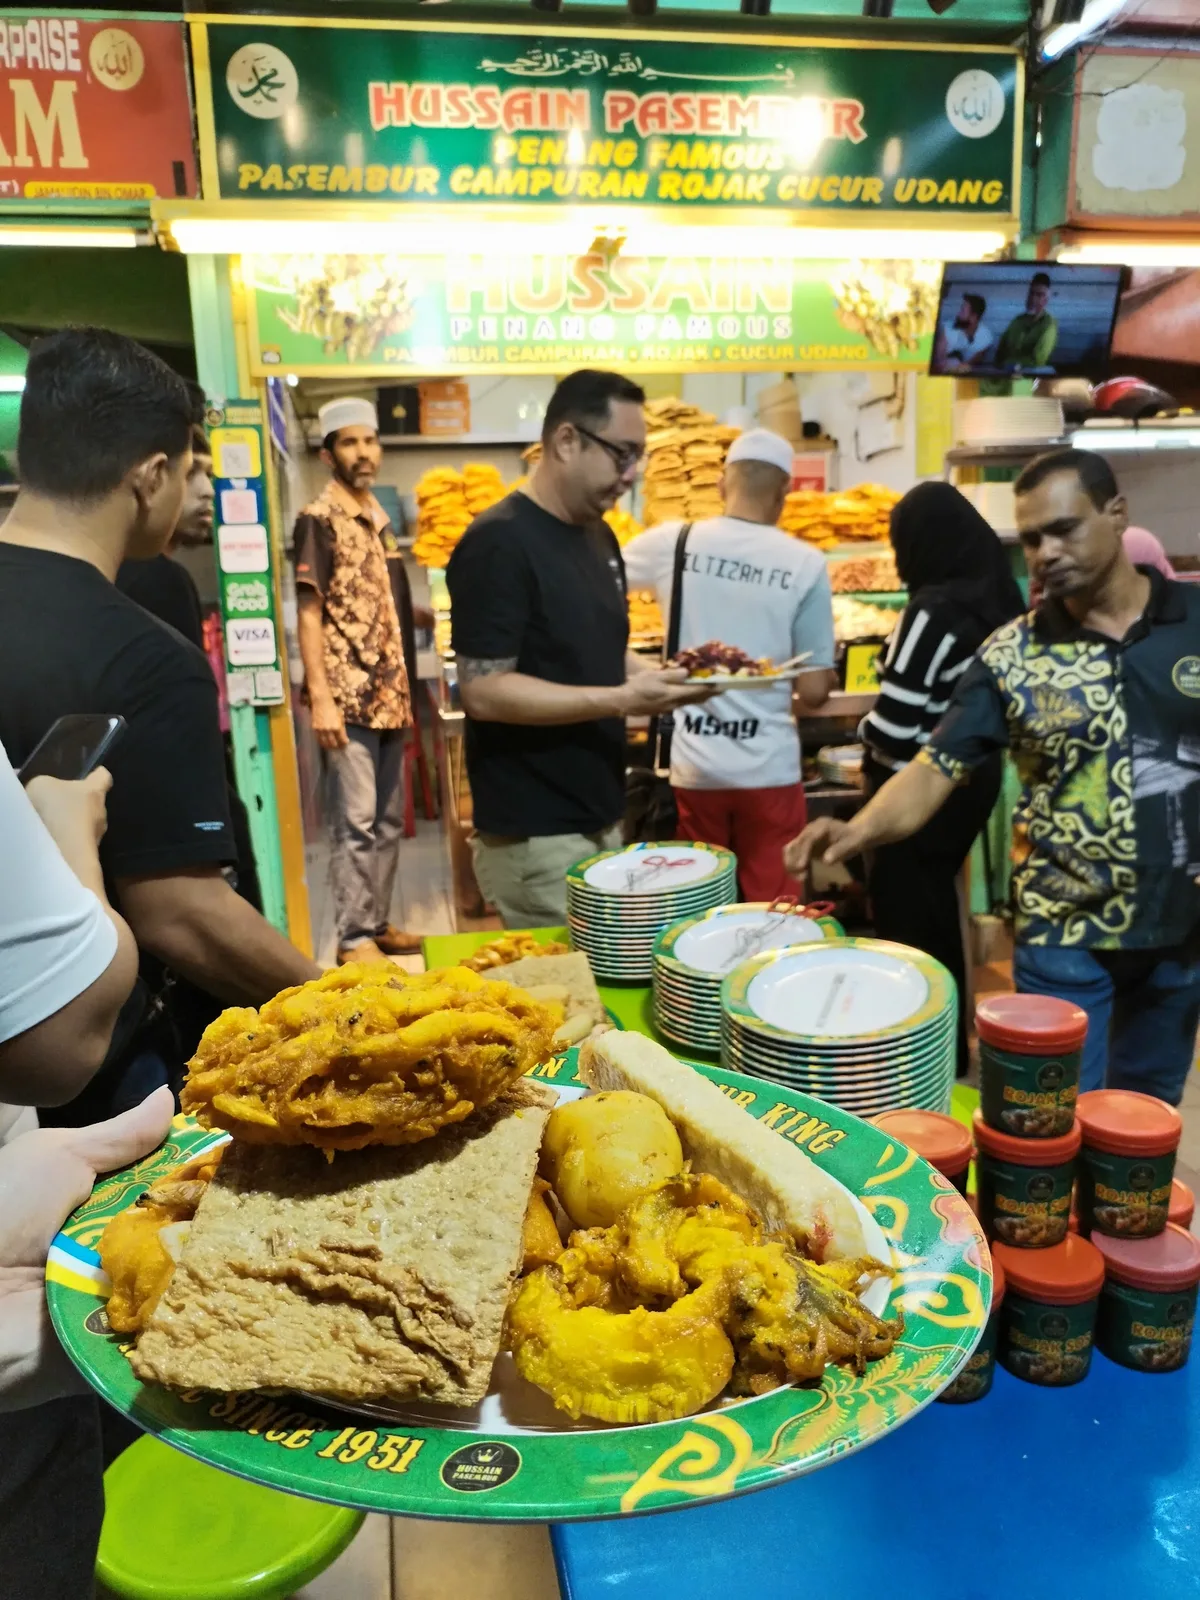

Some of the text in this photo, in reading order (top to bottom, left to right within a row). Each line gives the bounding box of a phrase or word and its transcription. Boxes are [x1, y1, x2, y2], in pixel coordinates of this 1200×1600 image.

[0, 78, 90, 168] M
[368, 81, 868, 145] HUSSAIN PASEMR
[493, 136, 638, 167] PENNG
[237, 162, 1003, 204] PASEMBUR CAMPURAN ROJAK CUCUR UDANG
[446, 254, 794, 314] HUSSAIN
[767, 568, 792, 590] FC
[234, 628, 271, 642] VISA
[1003, 1085, 1057, 1106] ROJAK
[758, 1101, 849, 1155] KING
[318, 1427, 425, 1474] 1951
[451, 1472, 498, 1482] PASEMBUR
[456, 1464, 503, 1475] HUSSAIN
